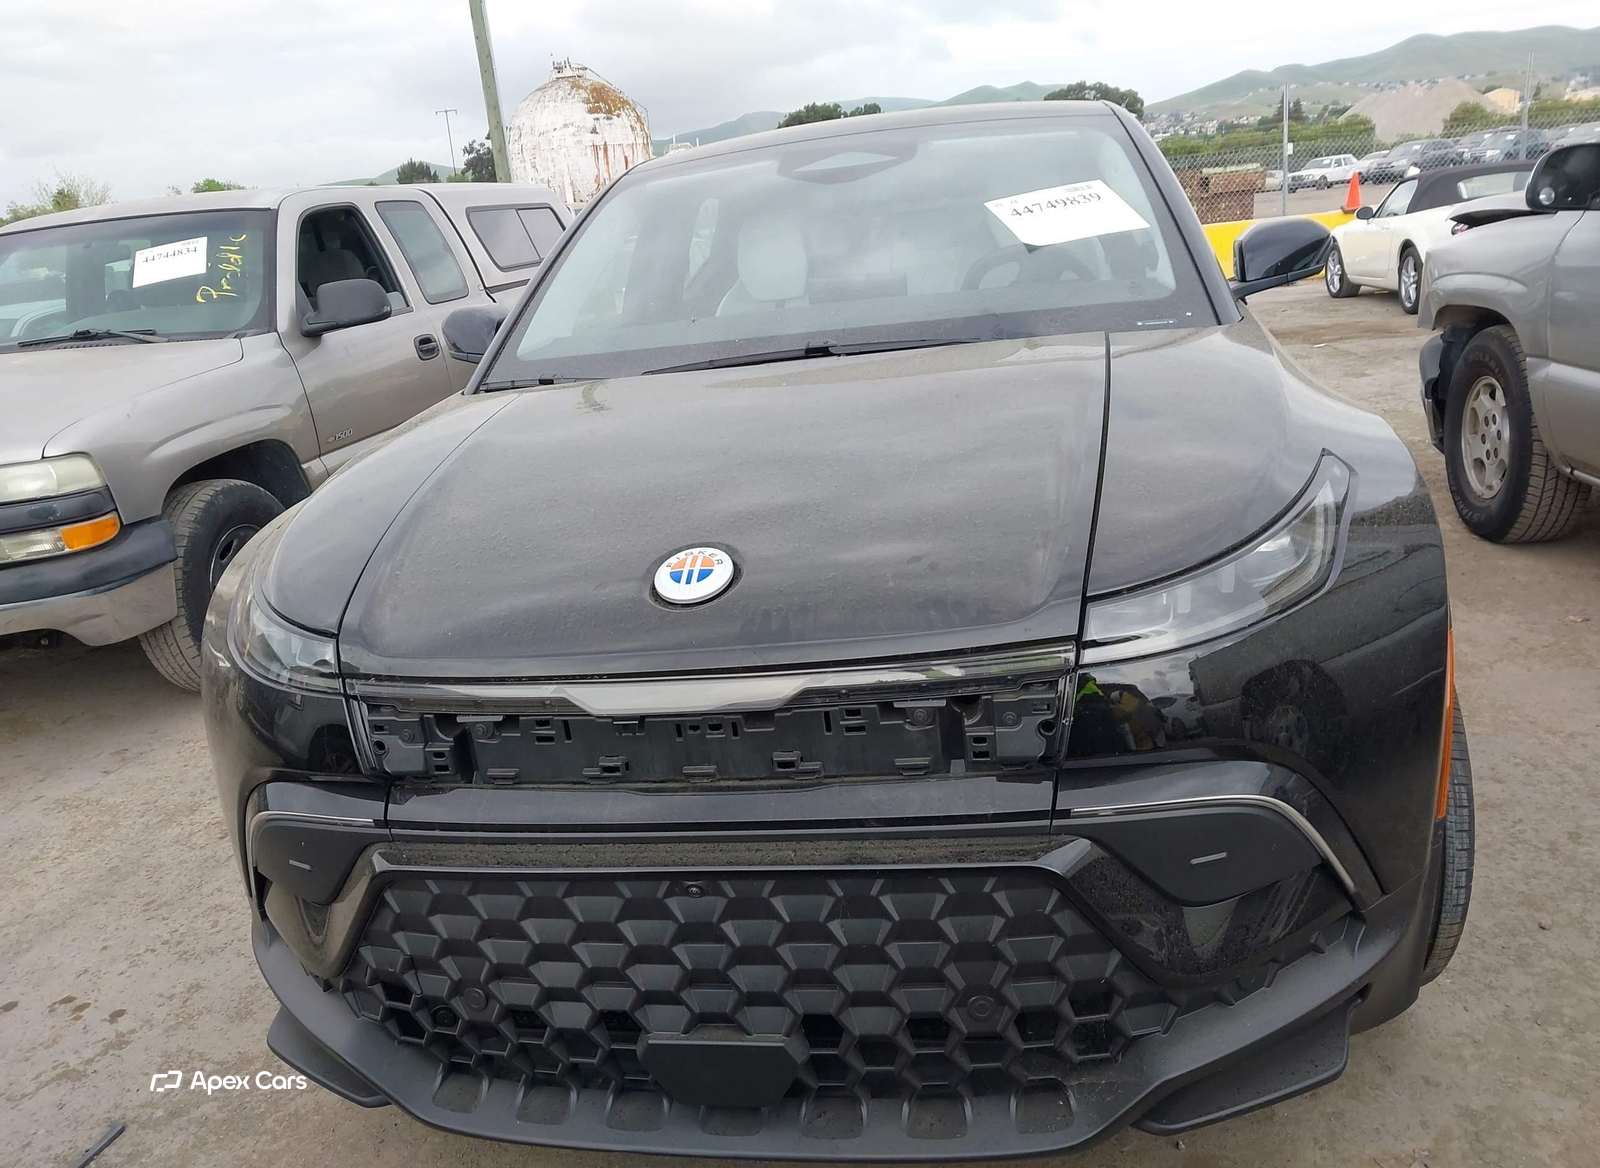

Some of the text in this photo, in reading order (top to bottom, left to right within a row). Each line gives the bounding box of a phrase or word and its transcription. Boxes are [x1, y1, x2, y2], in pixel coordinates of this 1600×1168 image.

[1011, 192, 1101, 217] 44749839
[142, 246, 198, 264] 44744834
[335, 428, 353, 441] 1500
[666, 550, 724, 568] FISKER
